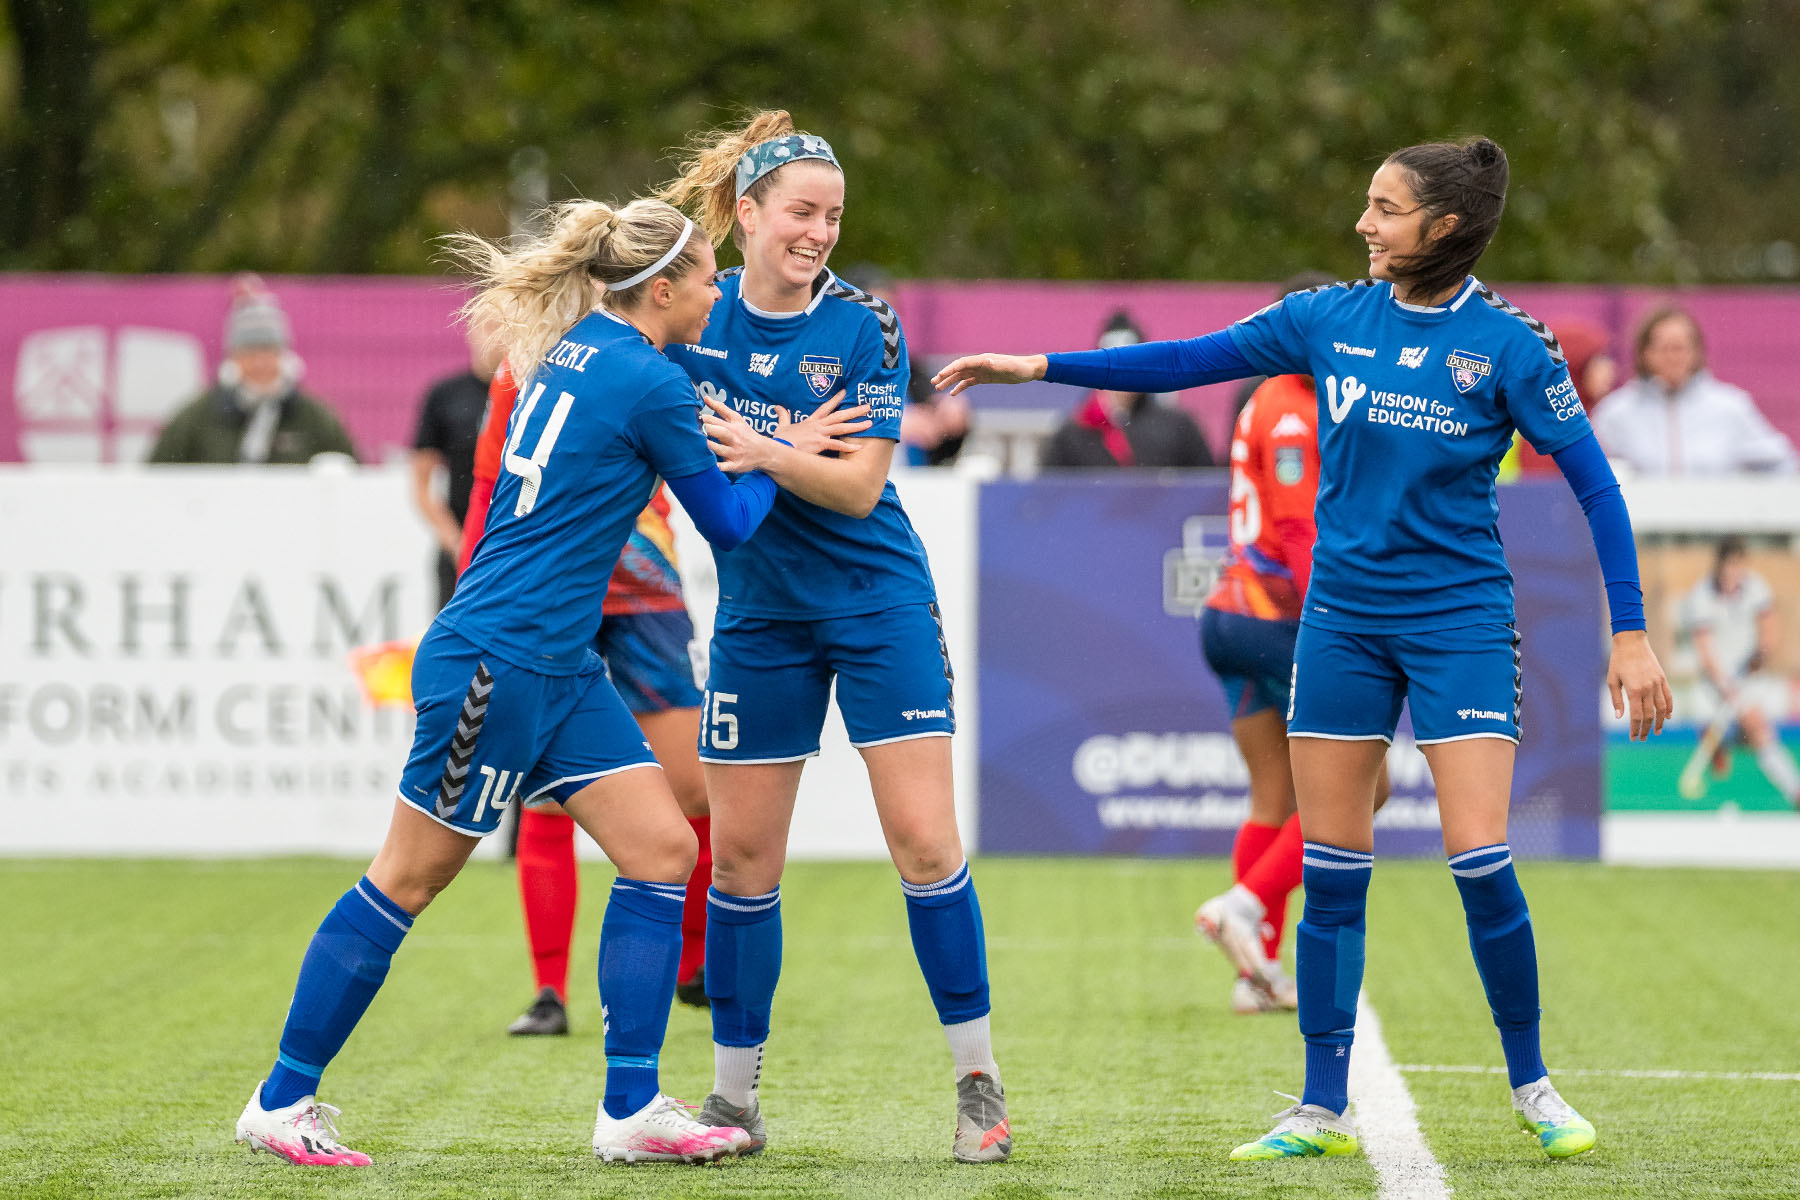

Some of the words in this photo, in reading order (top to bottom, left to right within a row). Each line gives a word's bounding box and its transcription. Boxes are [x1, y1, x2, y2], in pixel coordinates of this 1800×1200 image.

[692, 344, 729, 360] hummel
[1343, 344, 1377, 358] hummel
[801, 363, 841, 374] DURHAM
[1450, 357, 1489, 373] DURHAM
[733, 397, 791, 419] VISIO
[1371, 390, 1428, 413] VISION
[1430, 400, 1454, 417] for
[1367, 407, 1469, 437] EDUCATION
[501, 382, 576, 518] 4
[0, 570, 404, 660] RHAM
[701, 689, 739, 750] 15
[916, 708, 947, 720] hummel
[1471, 708, 1508, 722] hummel
